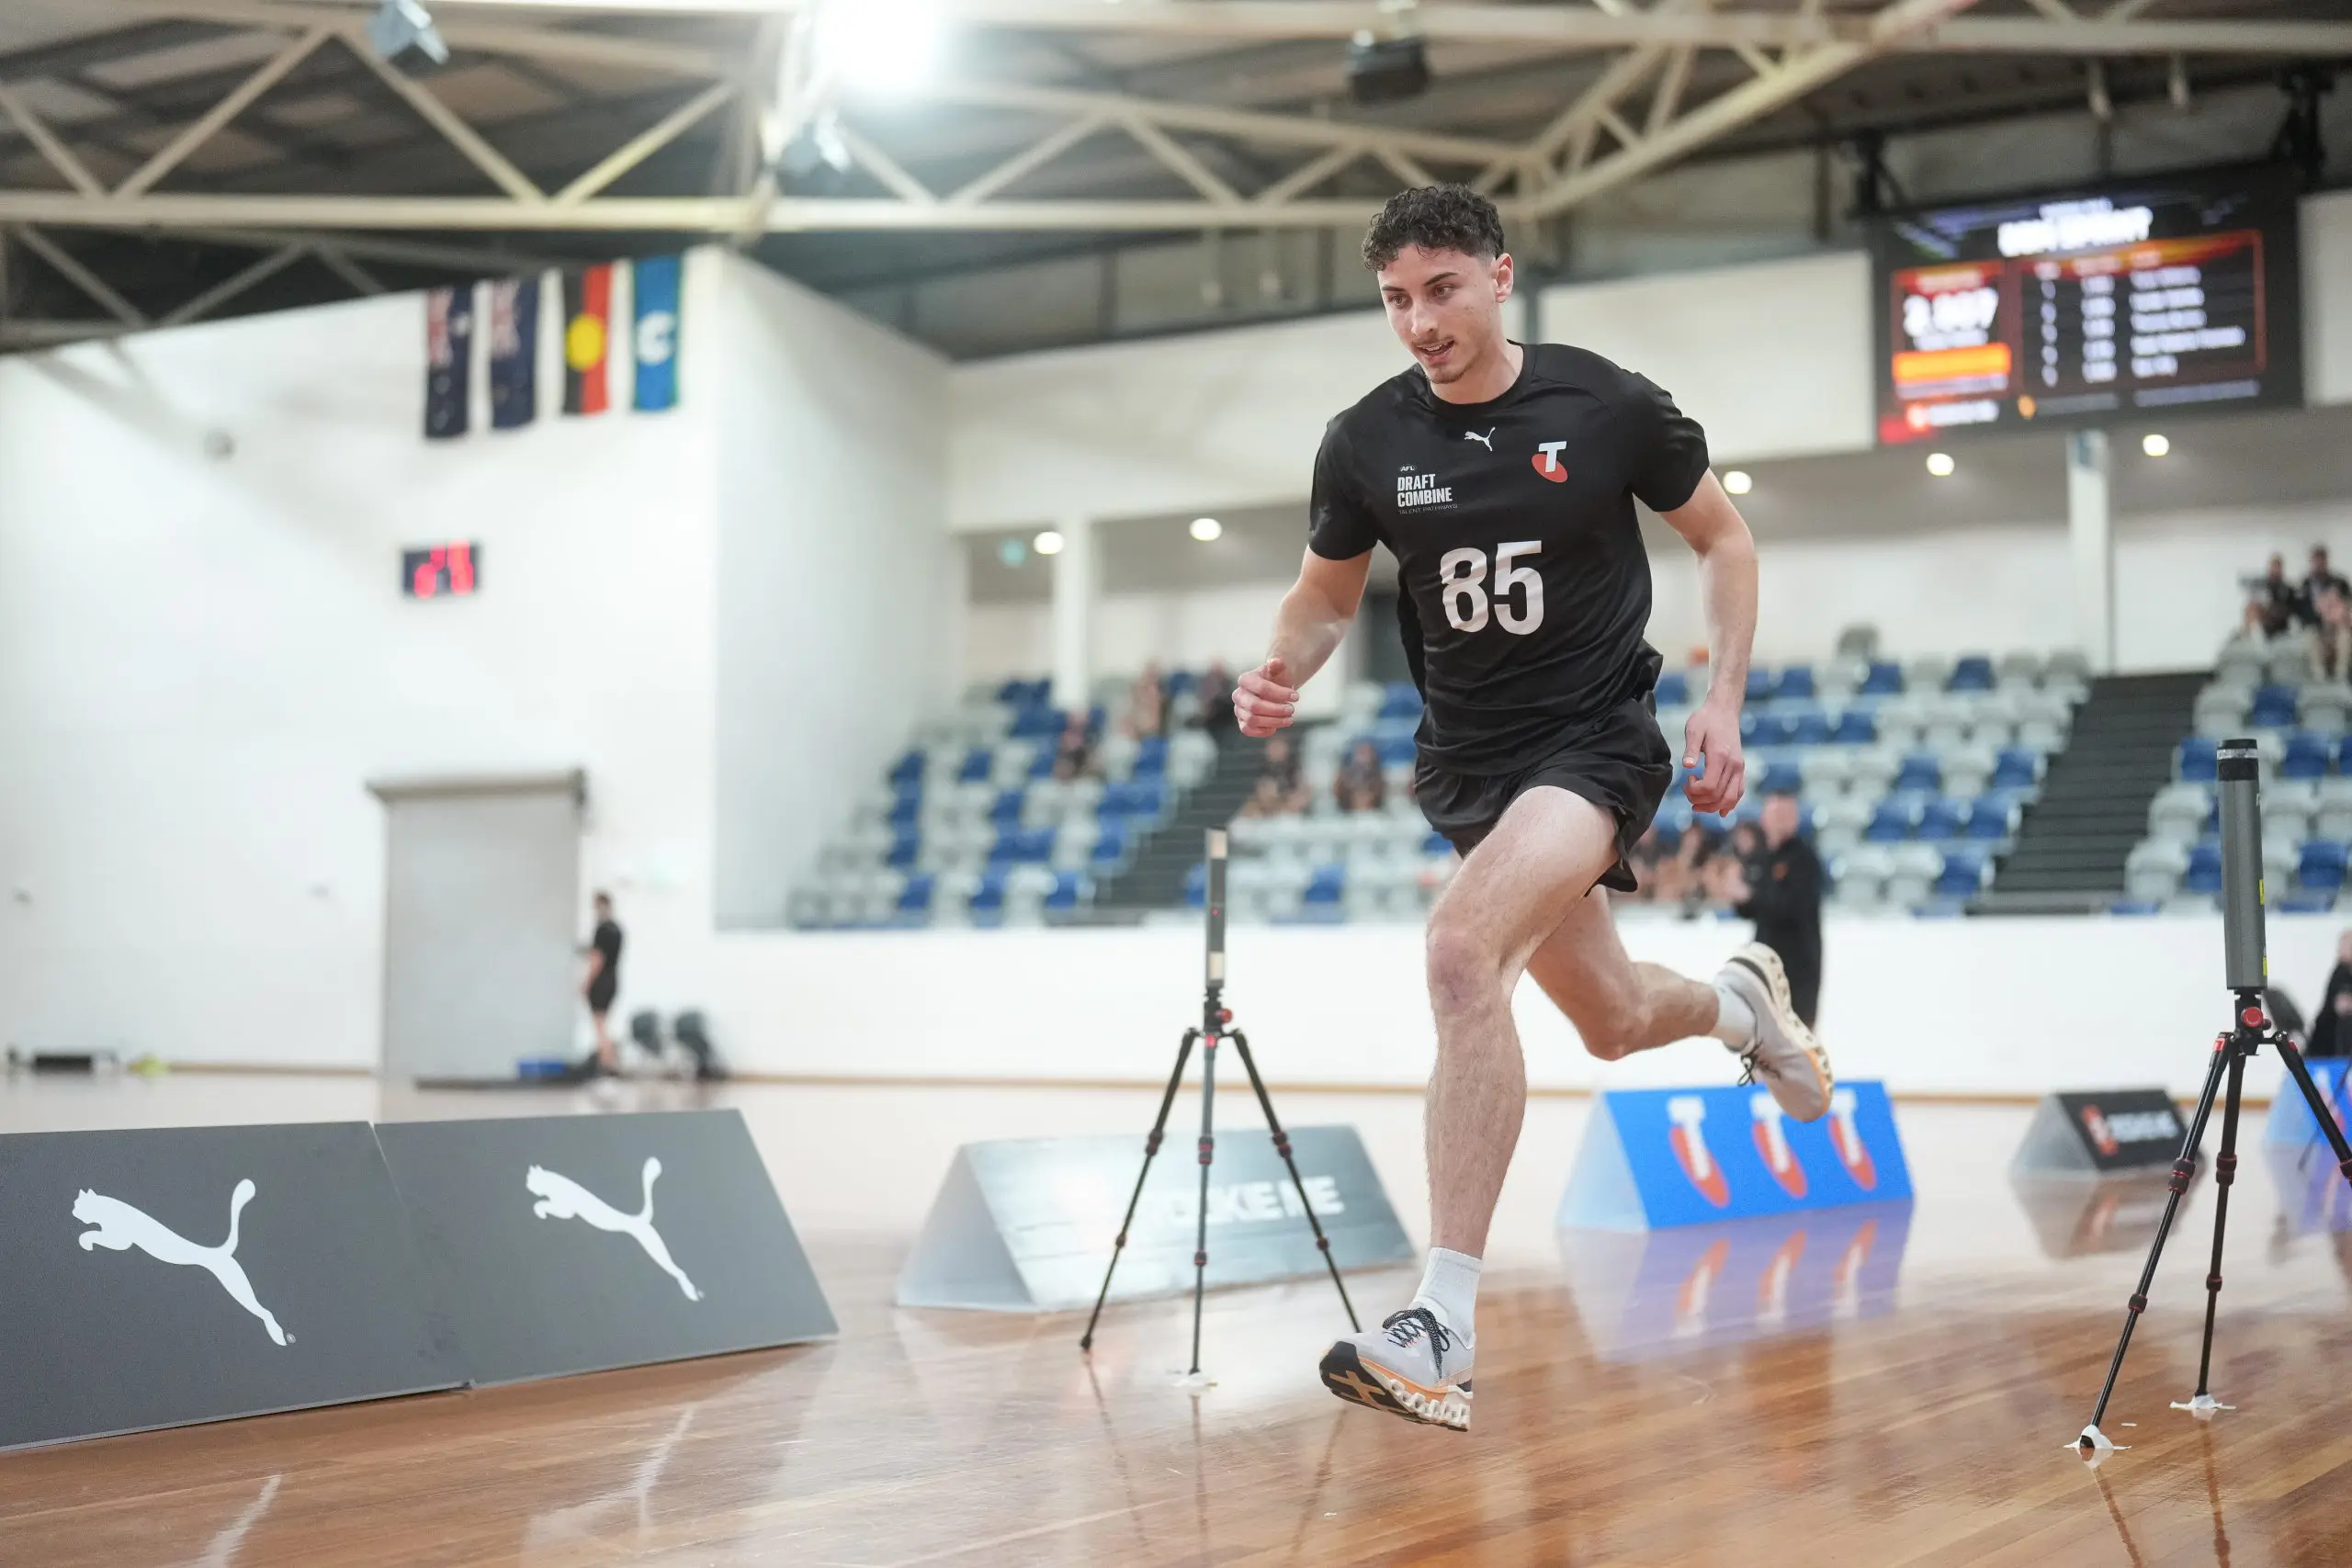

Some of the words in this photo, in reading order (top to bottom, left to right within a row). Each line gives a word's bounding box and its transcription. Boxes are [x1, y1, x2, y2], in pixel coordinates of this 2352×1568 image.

[1539, 441, 1566, 472] T
[1397, 474, 1435, 491] DRAFT
[1397, 487, 1453, 507] COMBINE
[1423, 503, 1457, 512] PATHWAYS
[1440, 540, 1544, 635] 85
[1667, 1095, 1711, 1180] T
